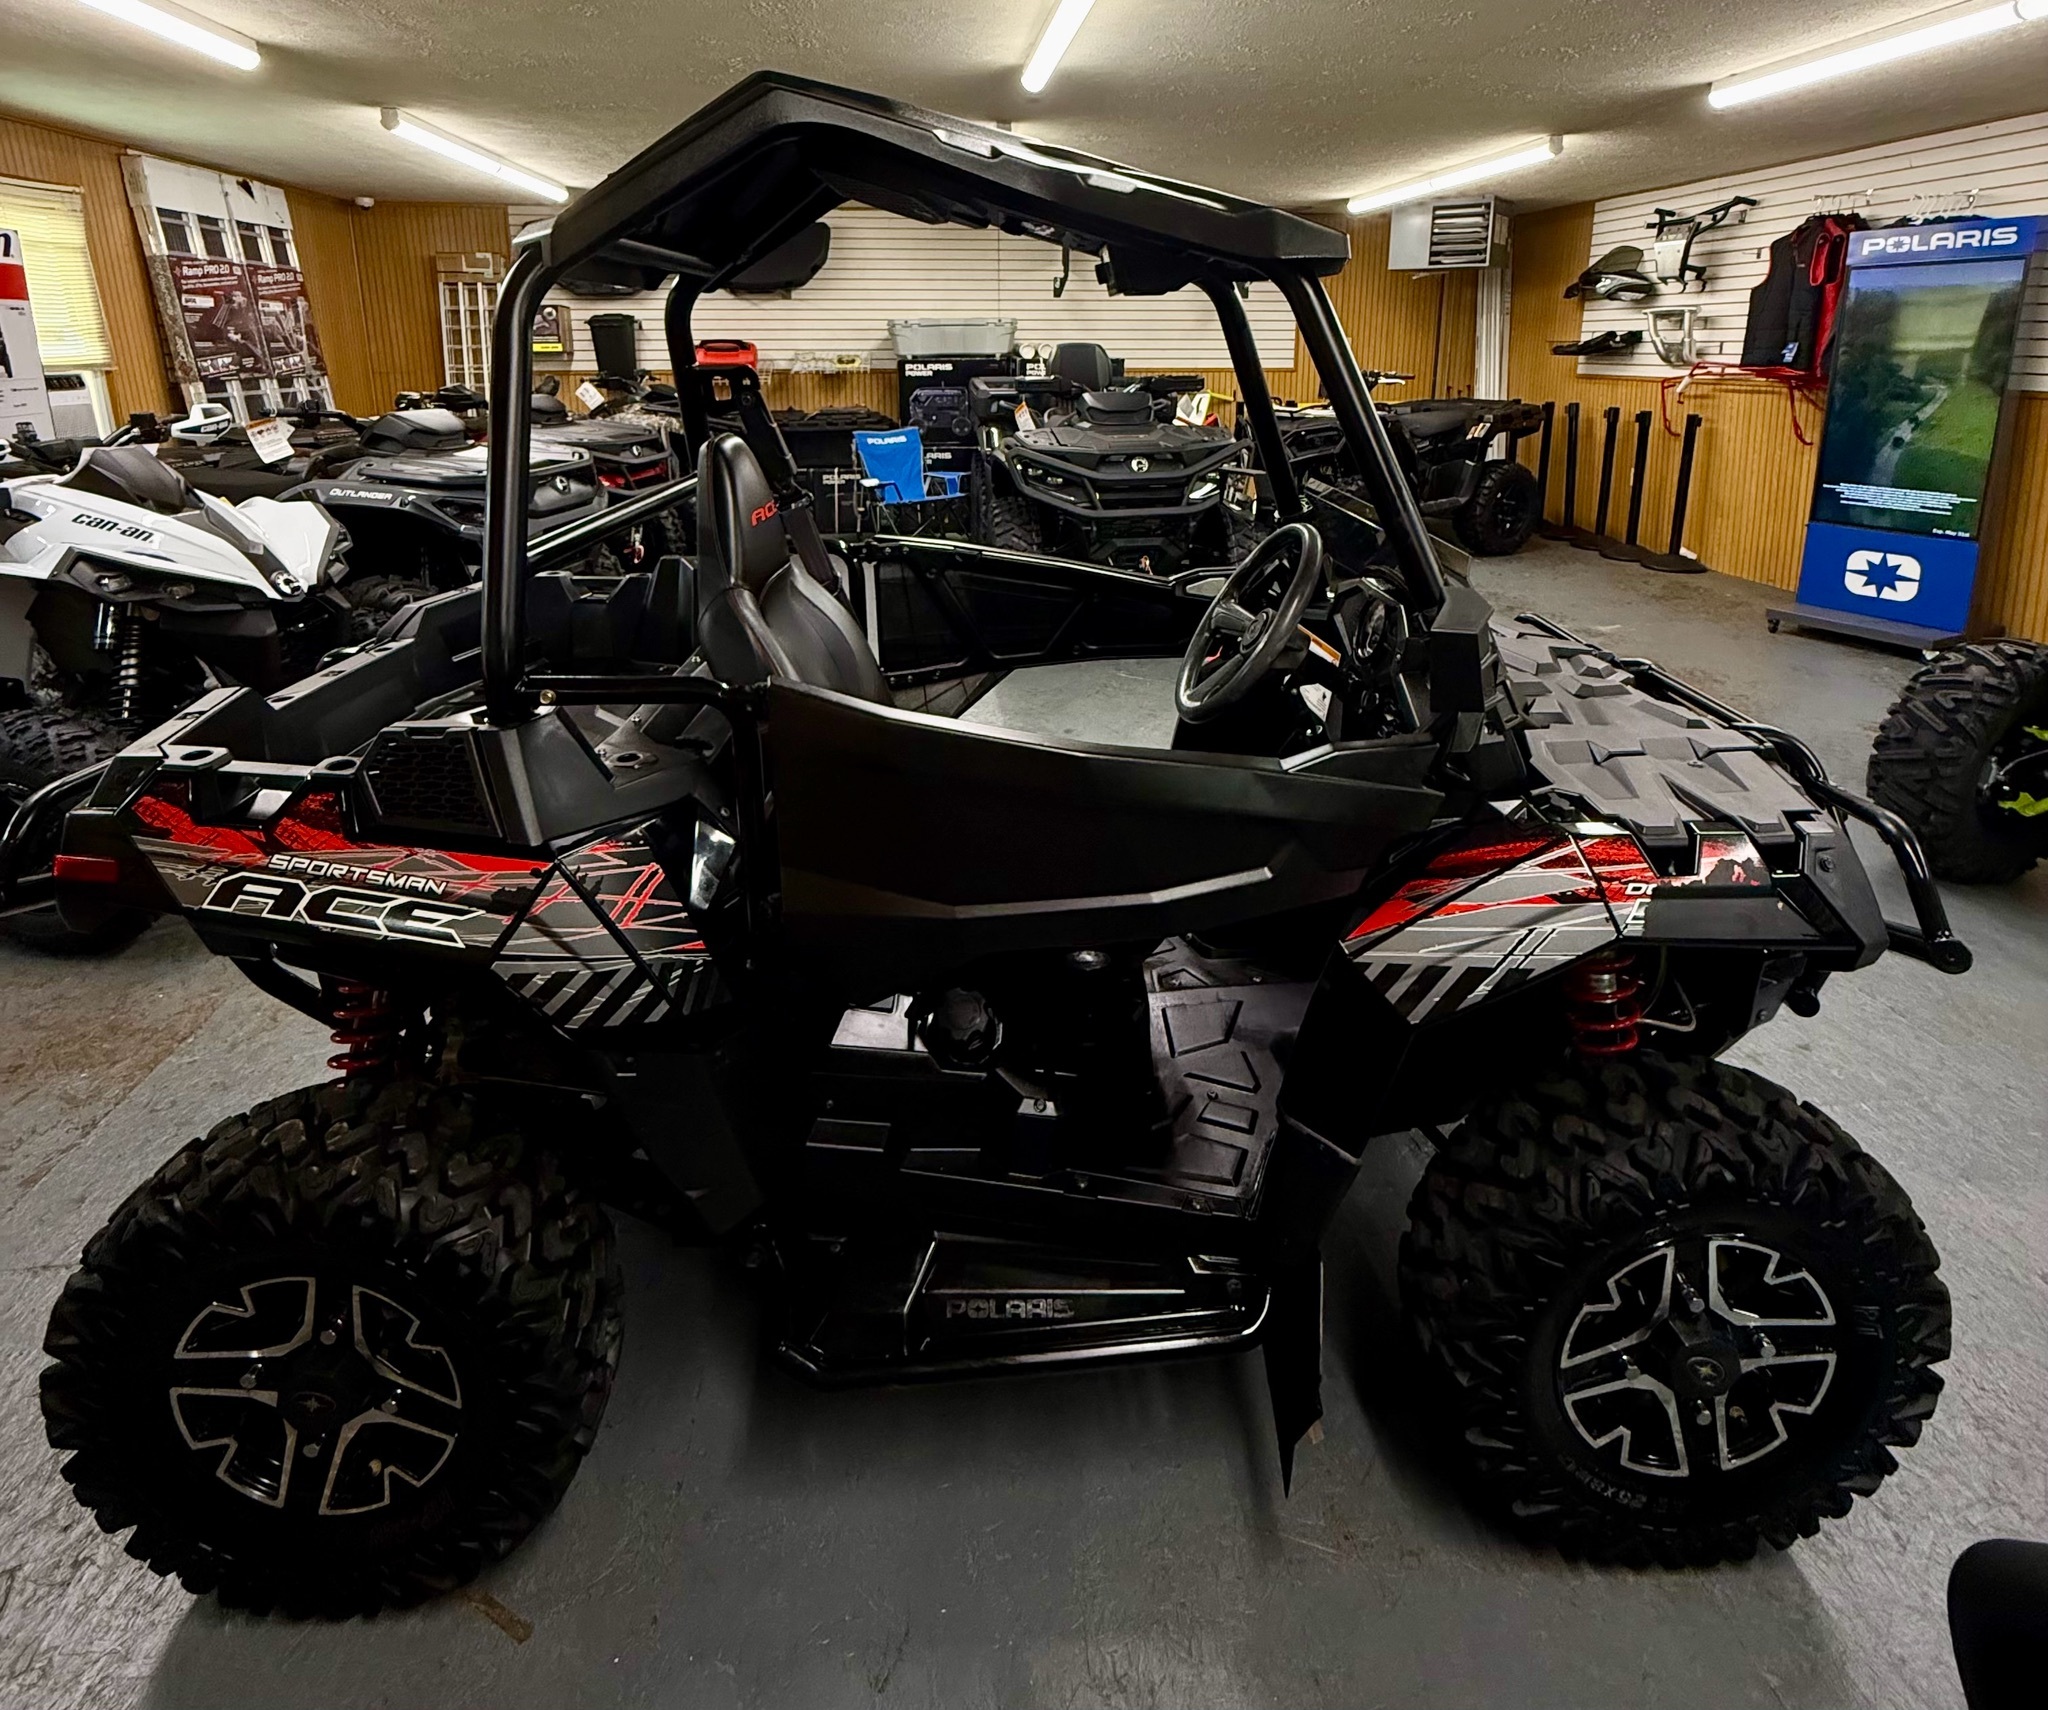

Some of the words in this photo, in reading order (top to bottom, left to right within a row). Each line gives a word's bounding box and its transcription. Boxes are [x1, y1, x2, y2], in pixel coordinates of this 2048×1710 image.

[1861, 226, 2018, 255] POLARIS
[182, 266, 203, 277] Ramp
[203, 264, 219, 275] PRO
[257, 274, 274, 284] Ramp
[273, 272, 286, 282] PRO
[905, 363, 953, 371] POLARIS
[866, 435, 907, 445] POLARIS
[329, 487, 393, 500] OUTLANDER
[268, 853, 449, 896] SPORTSMAN
[201, 871, 484, 949] ACE
[945, 1298, 1075, 1319] POLARIS
